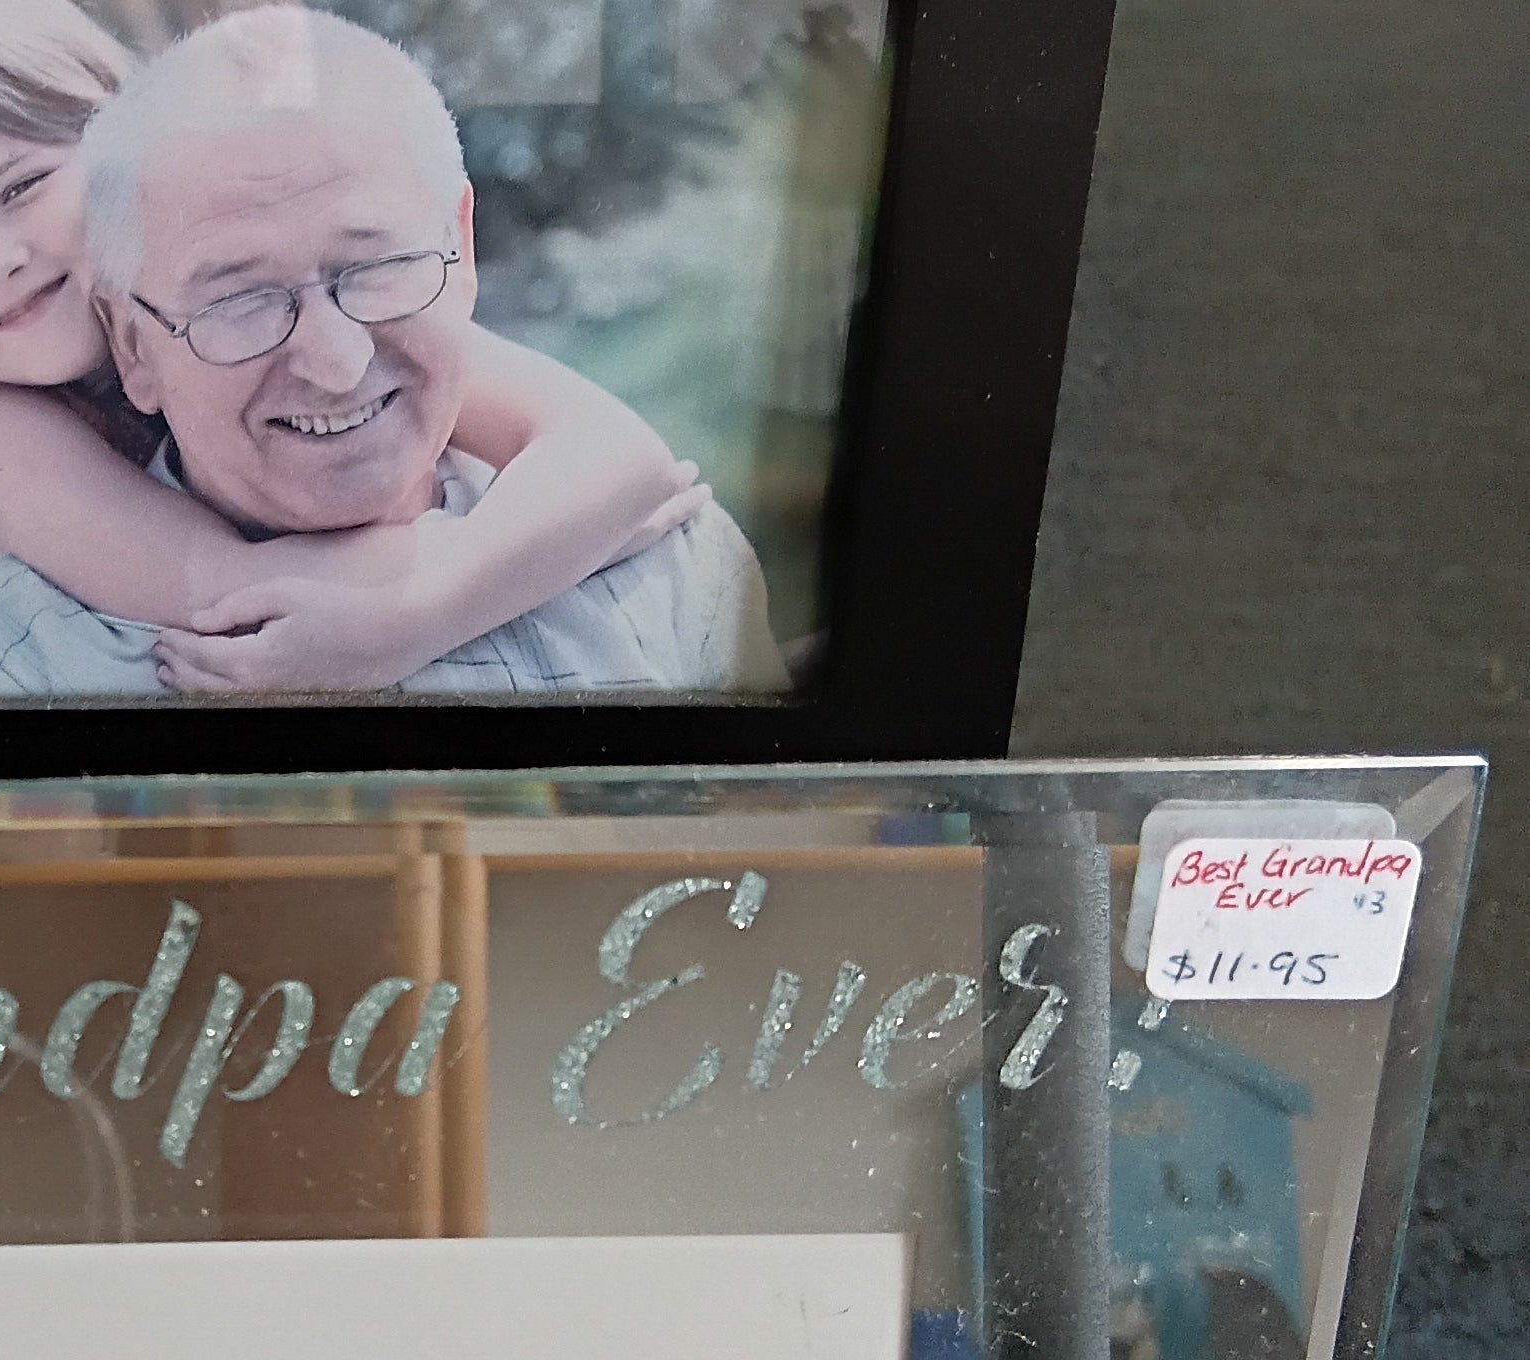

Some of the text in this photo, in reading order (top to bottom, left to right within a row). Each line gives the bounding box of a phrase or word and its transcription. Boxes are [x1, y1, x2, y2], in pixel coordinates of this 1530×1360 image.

[1171, 840, 1412, 887] Best Grandpa
[1215, 882, 1313, 910] Ever
[1162, 950, 1339, 985] $11.95
